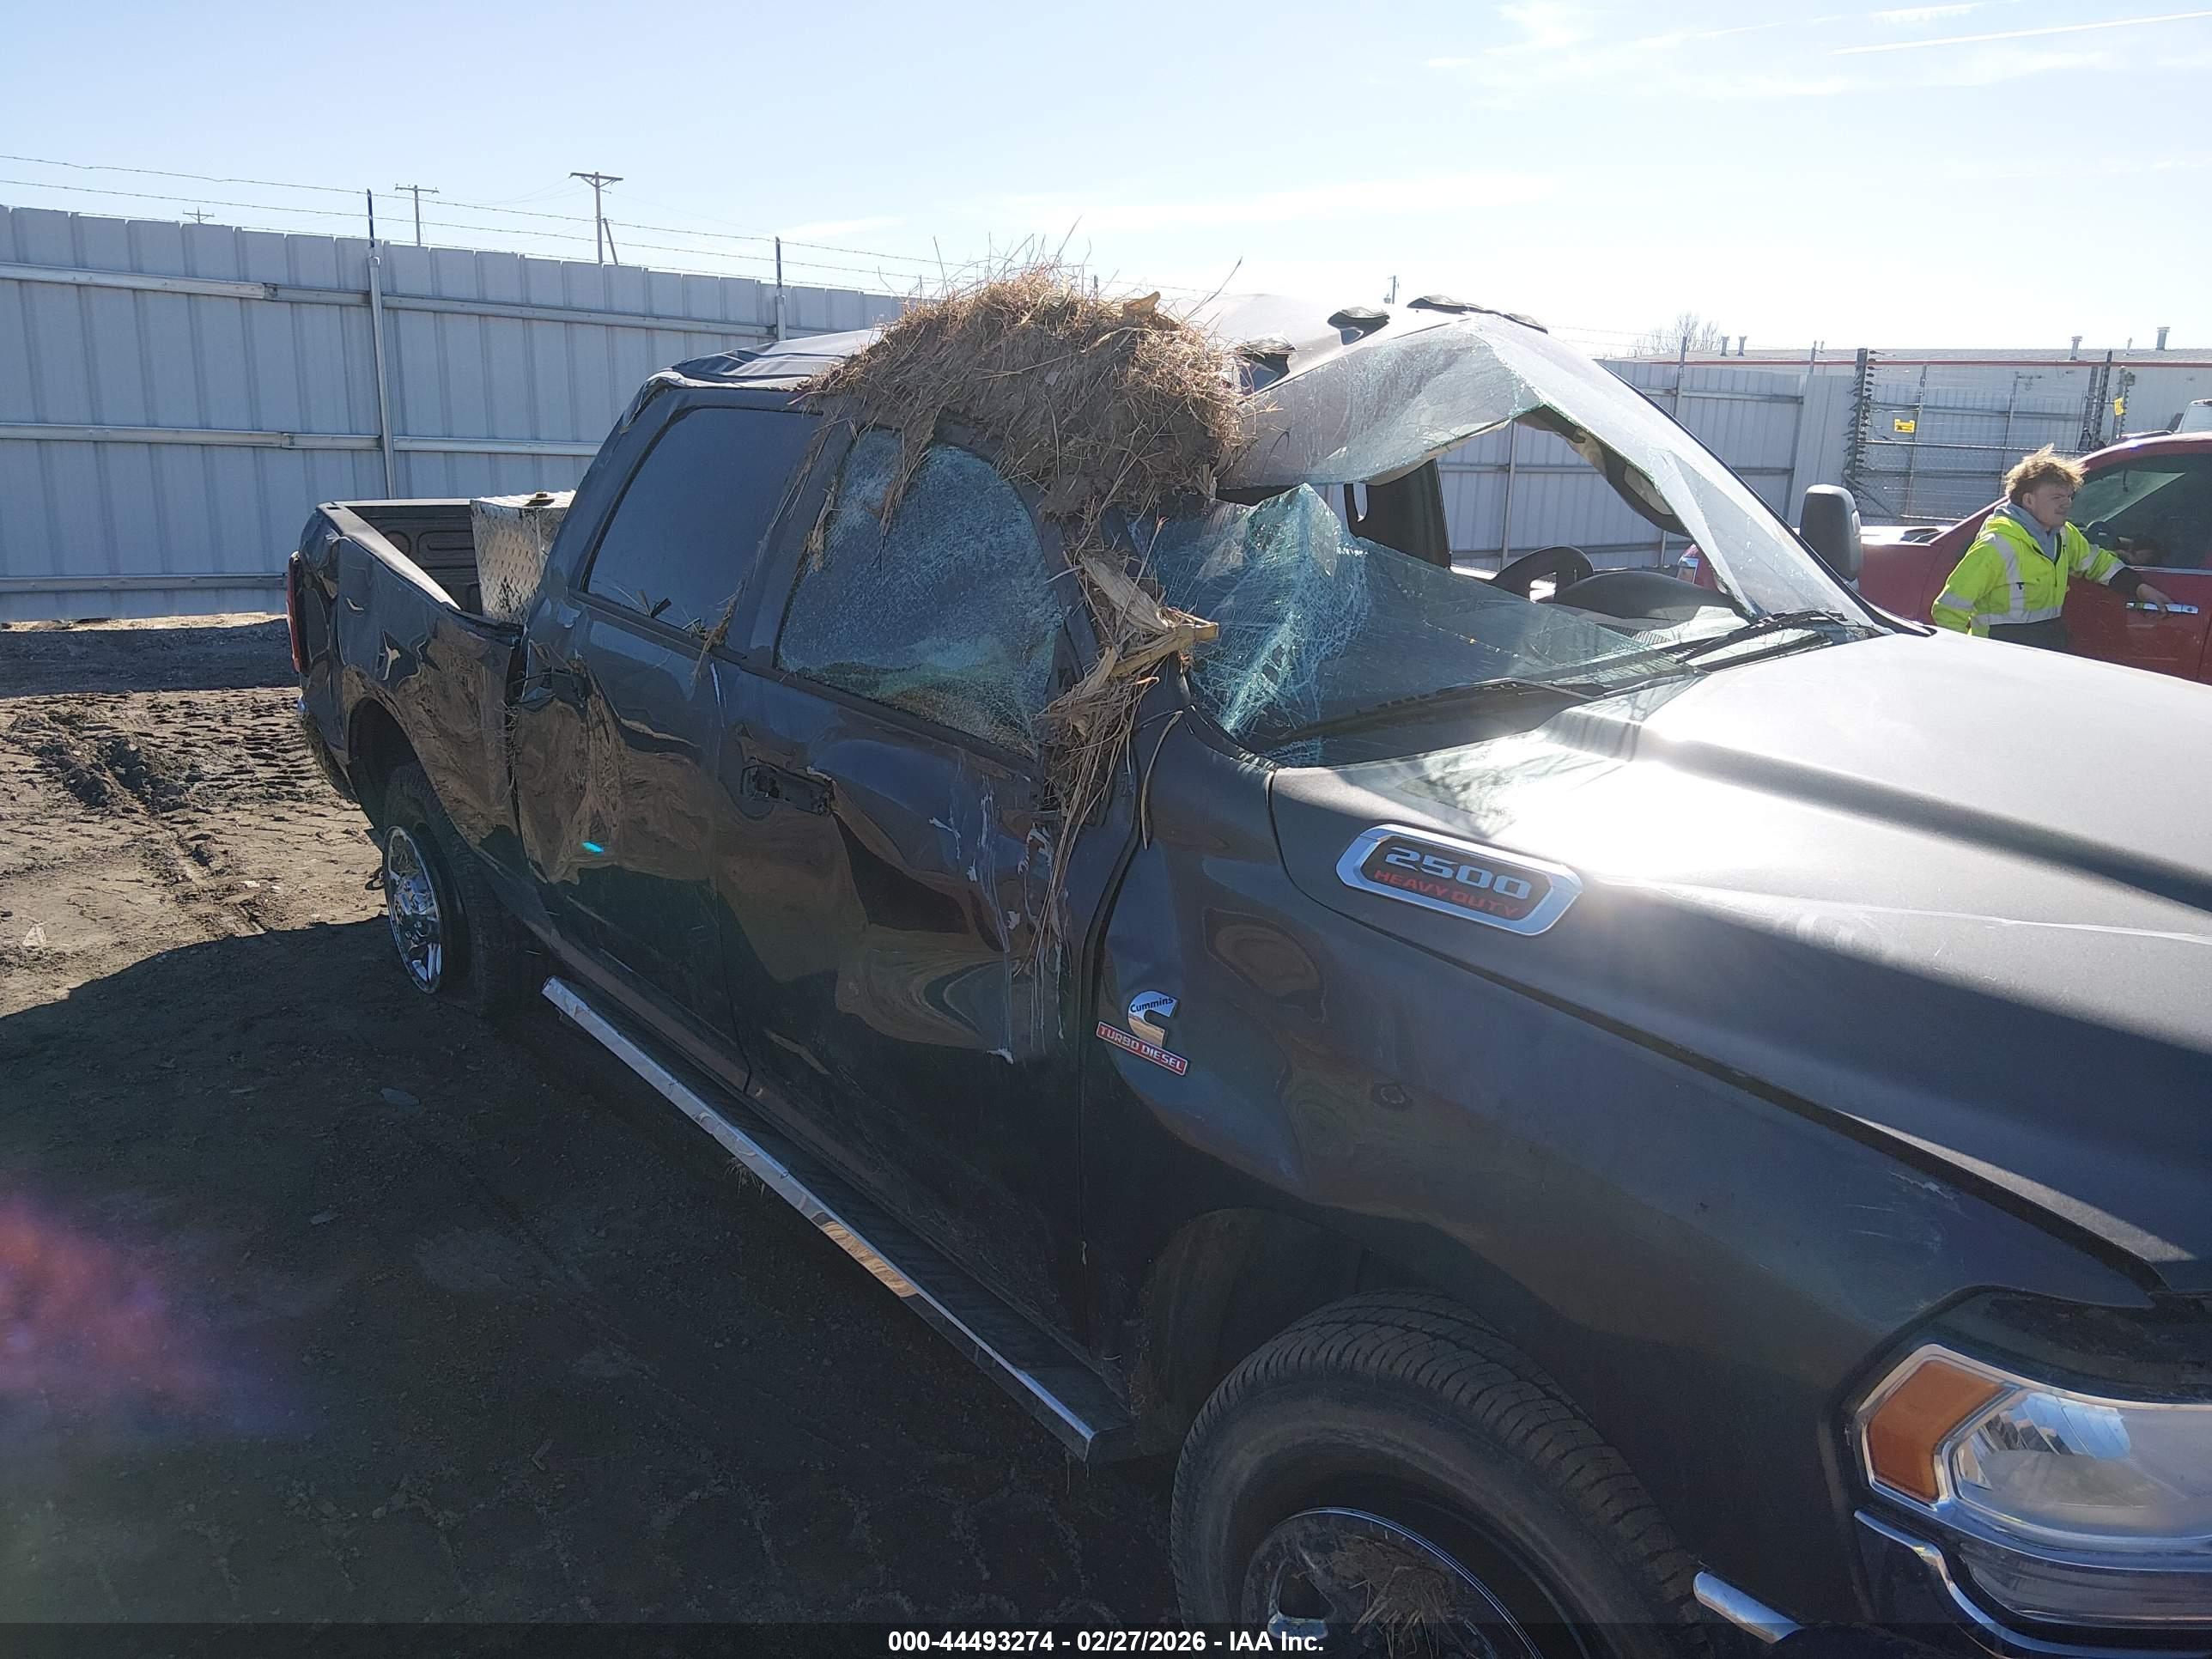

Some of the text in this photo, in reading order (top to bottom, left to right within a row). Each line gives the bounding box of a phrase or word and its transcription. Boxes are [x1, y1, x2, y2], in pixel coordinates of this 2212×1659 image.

[1375, 870, 1519, 917] HEAVY DUTY
[1385, 847, 1532, 899] 2500
[1130, 997, 1174, 1013] Cummins
[1099, 1025, 1182, 1071] TURBO DIESEL
